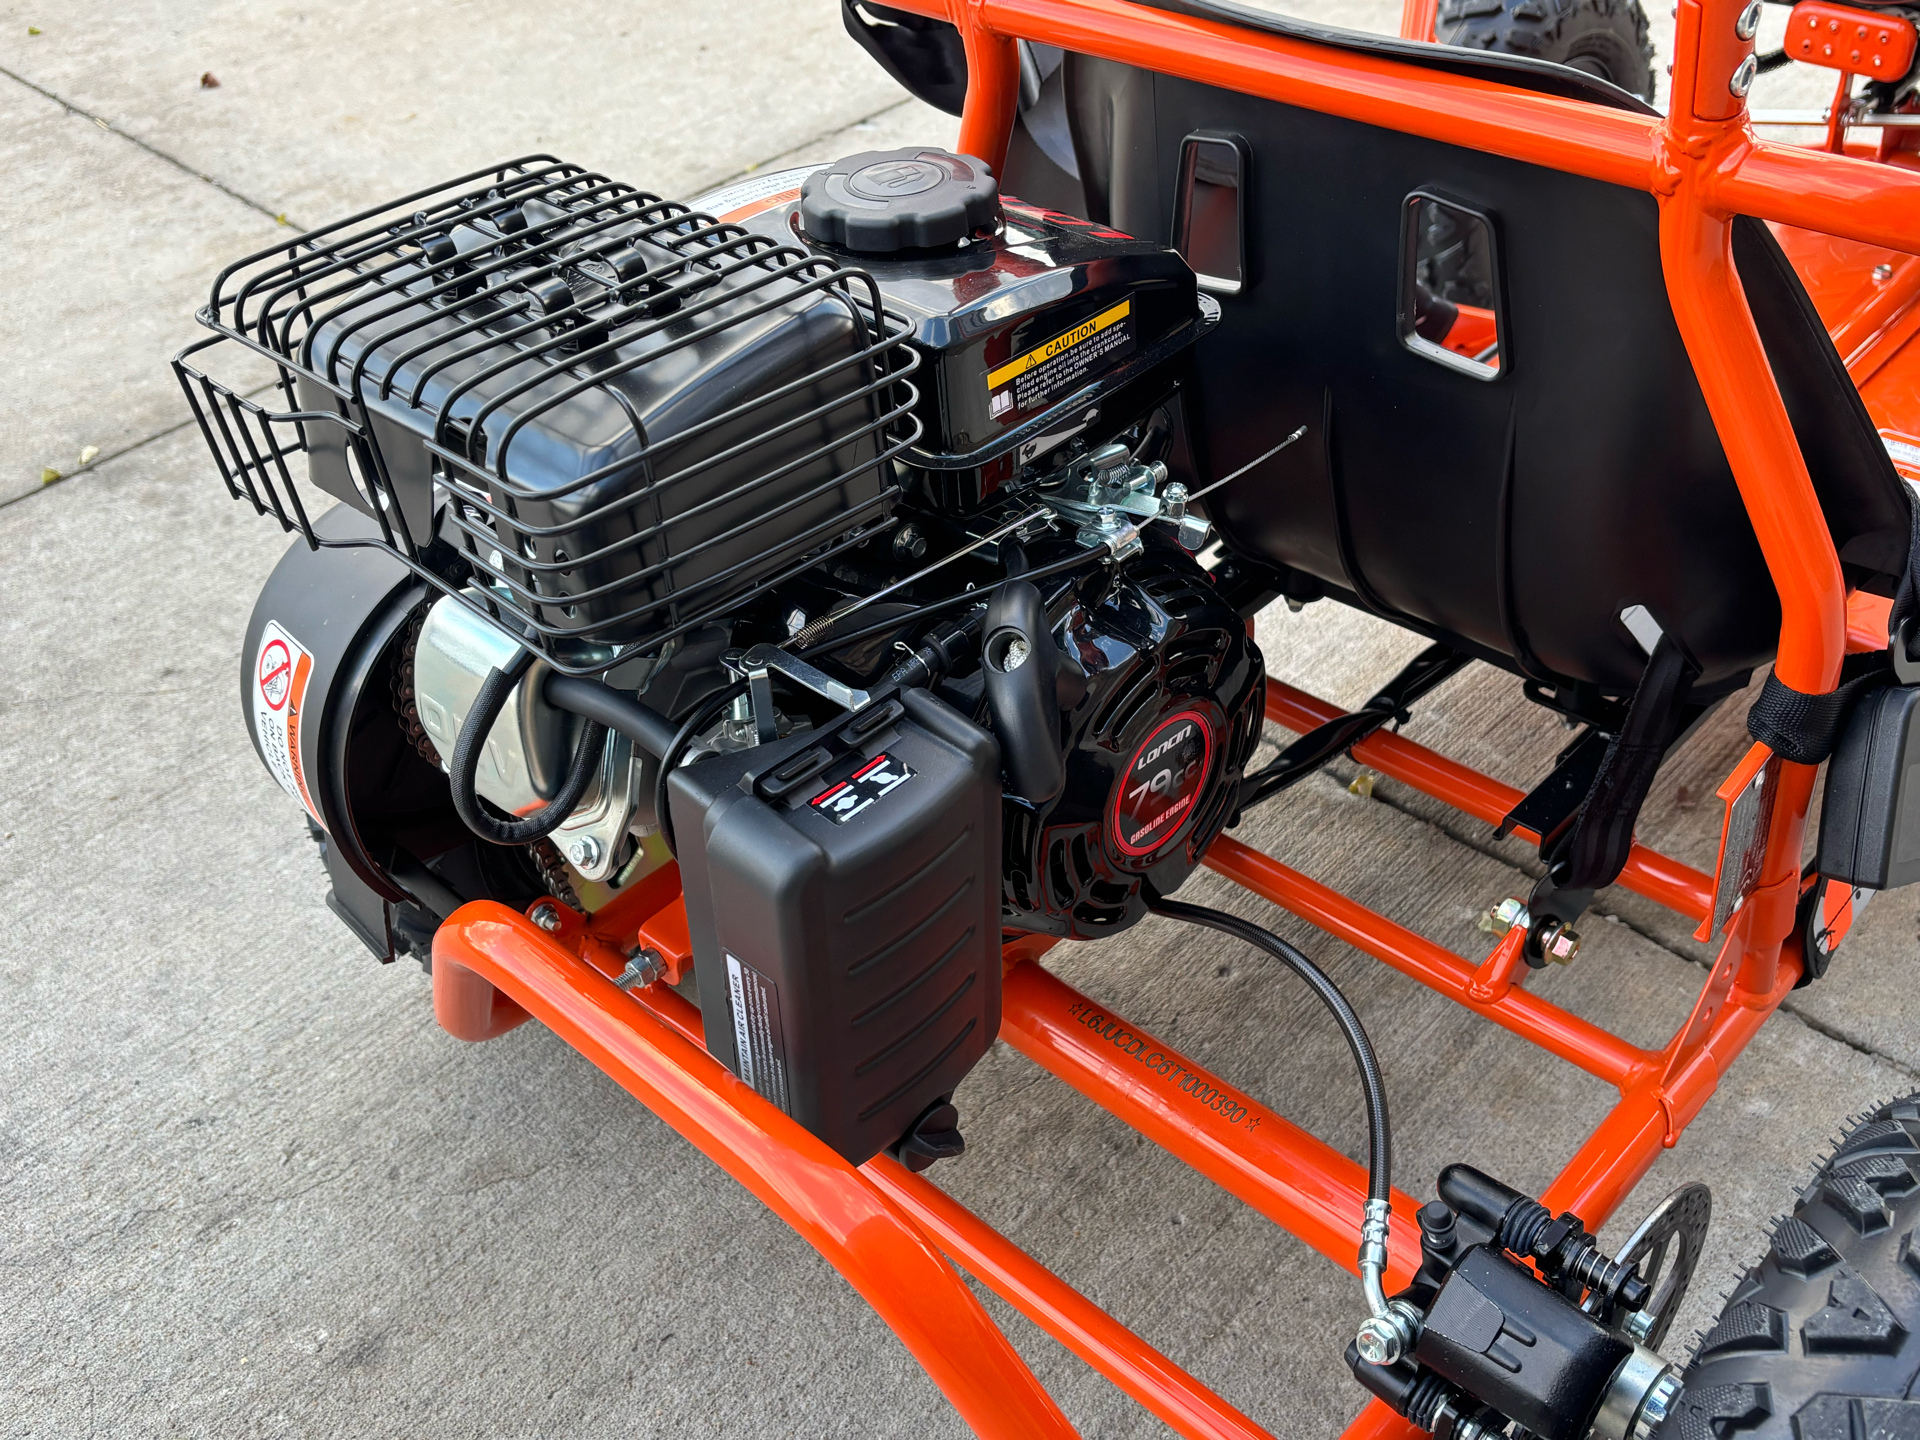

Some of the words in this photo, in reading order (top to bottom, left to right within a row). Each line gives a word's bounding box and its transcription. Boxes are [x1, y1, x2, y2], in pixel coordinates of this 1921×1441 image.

[1016, 370, 1038, 386] Before
[1079, 340, 1093, 351] sure
[1101, 327, 1112, 339] add
[1113, 321, 1126, 331] spe-
[1046, 320, 1096, 357] CAUTION
[1016, 379, 1035, 394] cified
[1036, 367, 1057, 384] engine
[1067, 355, 1080, 366] into
[1080, 349, 1090, 358] the
[1091, 332, 1123, 352] crankcase.
[1017, 387, 1039, 402] Please
[1040, 376, 1055, 389] refer
[1063, 366, 1073, 376] the
[1074, 349, 1104, 370] OWNER'S
[1104, 333, 1131, 353] MANUAL
[1018, 400, 1028, 410] for
[1029, 388, 1051, 404] further
[1051, 367, 1089, 391] information.
[891, 667, 909, 682] EPA
[260, 711, 279, 771] VEHICLE
[268, 717, 276, 741] ON
[276, 724, 284, 748] DO
[1137, 724, 1192, 771] LONCIN
[289, 724, 309, 800] WARNING
[1130, 813, 1165, 845] GASOLINE
[1165, 793, 1192, 819] ENGINE
[732, 973, 742, 1020] CLEANER
[737, 1019, 745, 1037] AIR
[740, 1036, 751, 1083] MAINTAIN
